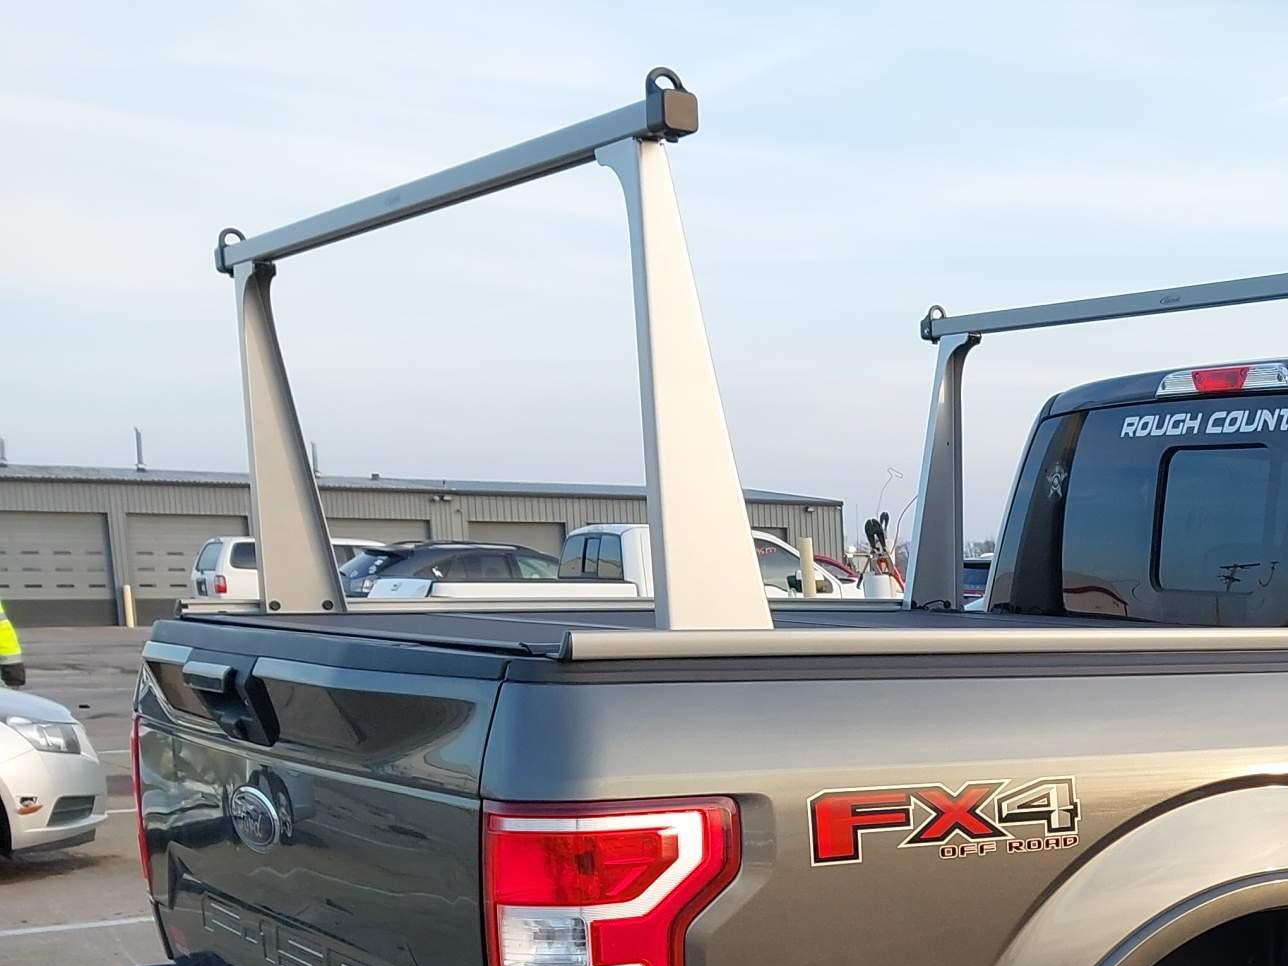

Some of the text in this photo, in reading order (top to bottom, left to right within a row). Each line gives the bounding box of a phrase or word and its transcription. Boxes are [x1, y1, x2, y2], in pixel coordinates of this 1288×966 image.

[1120, 413, 1202, 438] ROUGH
[807, 775, 1081, 867] FX4
[939, 834, 1080, 859] OFF ROAD
